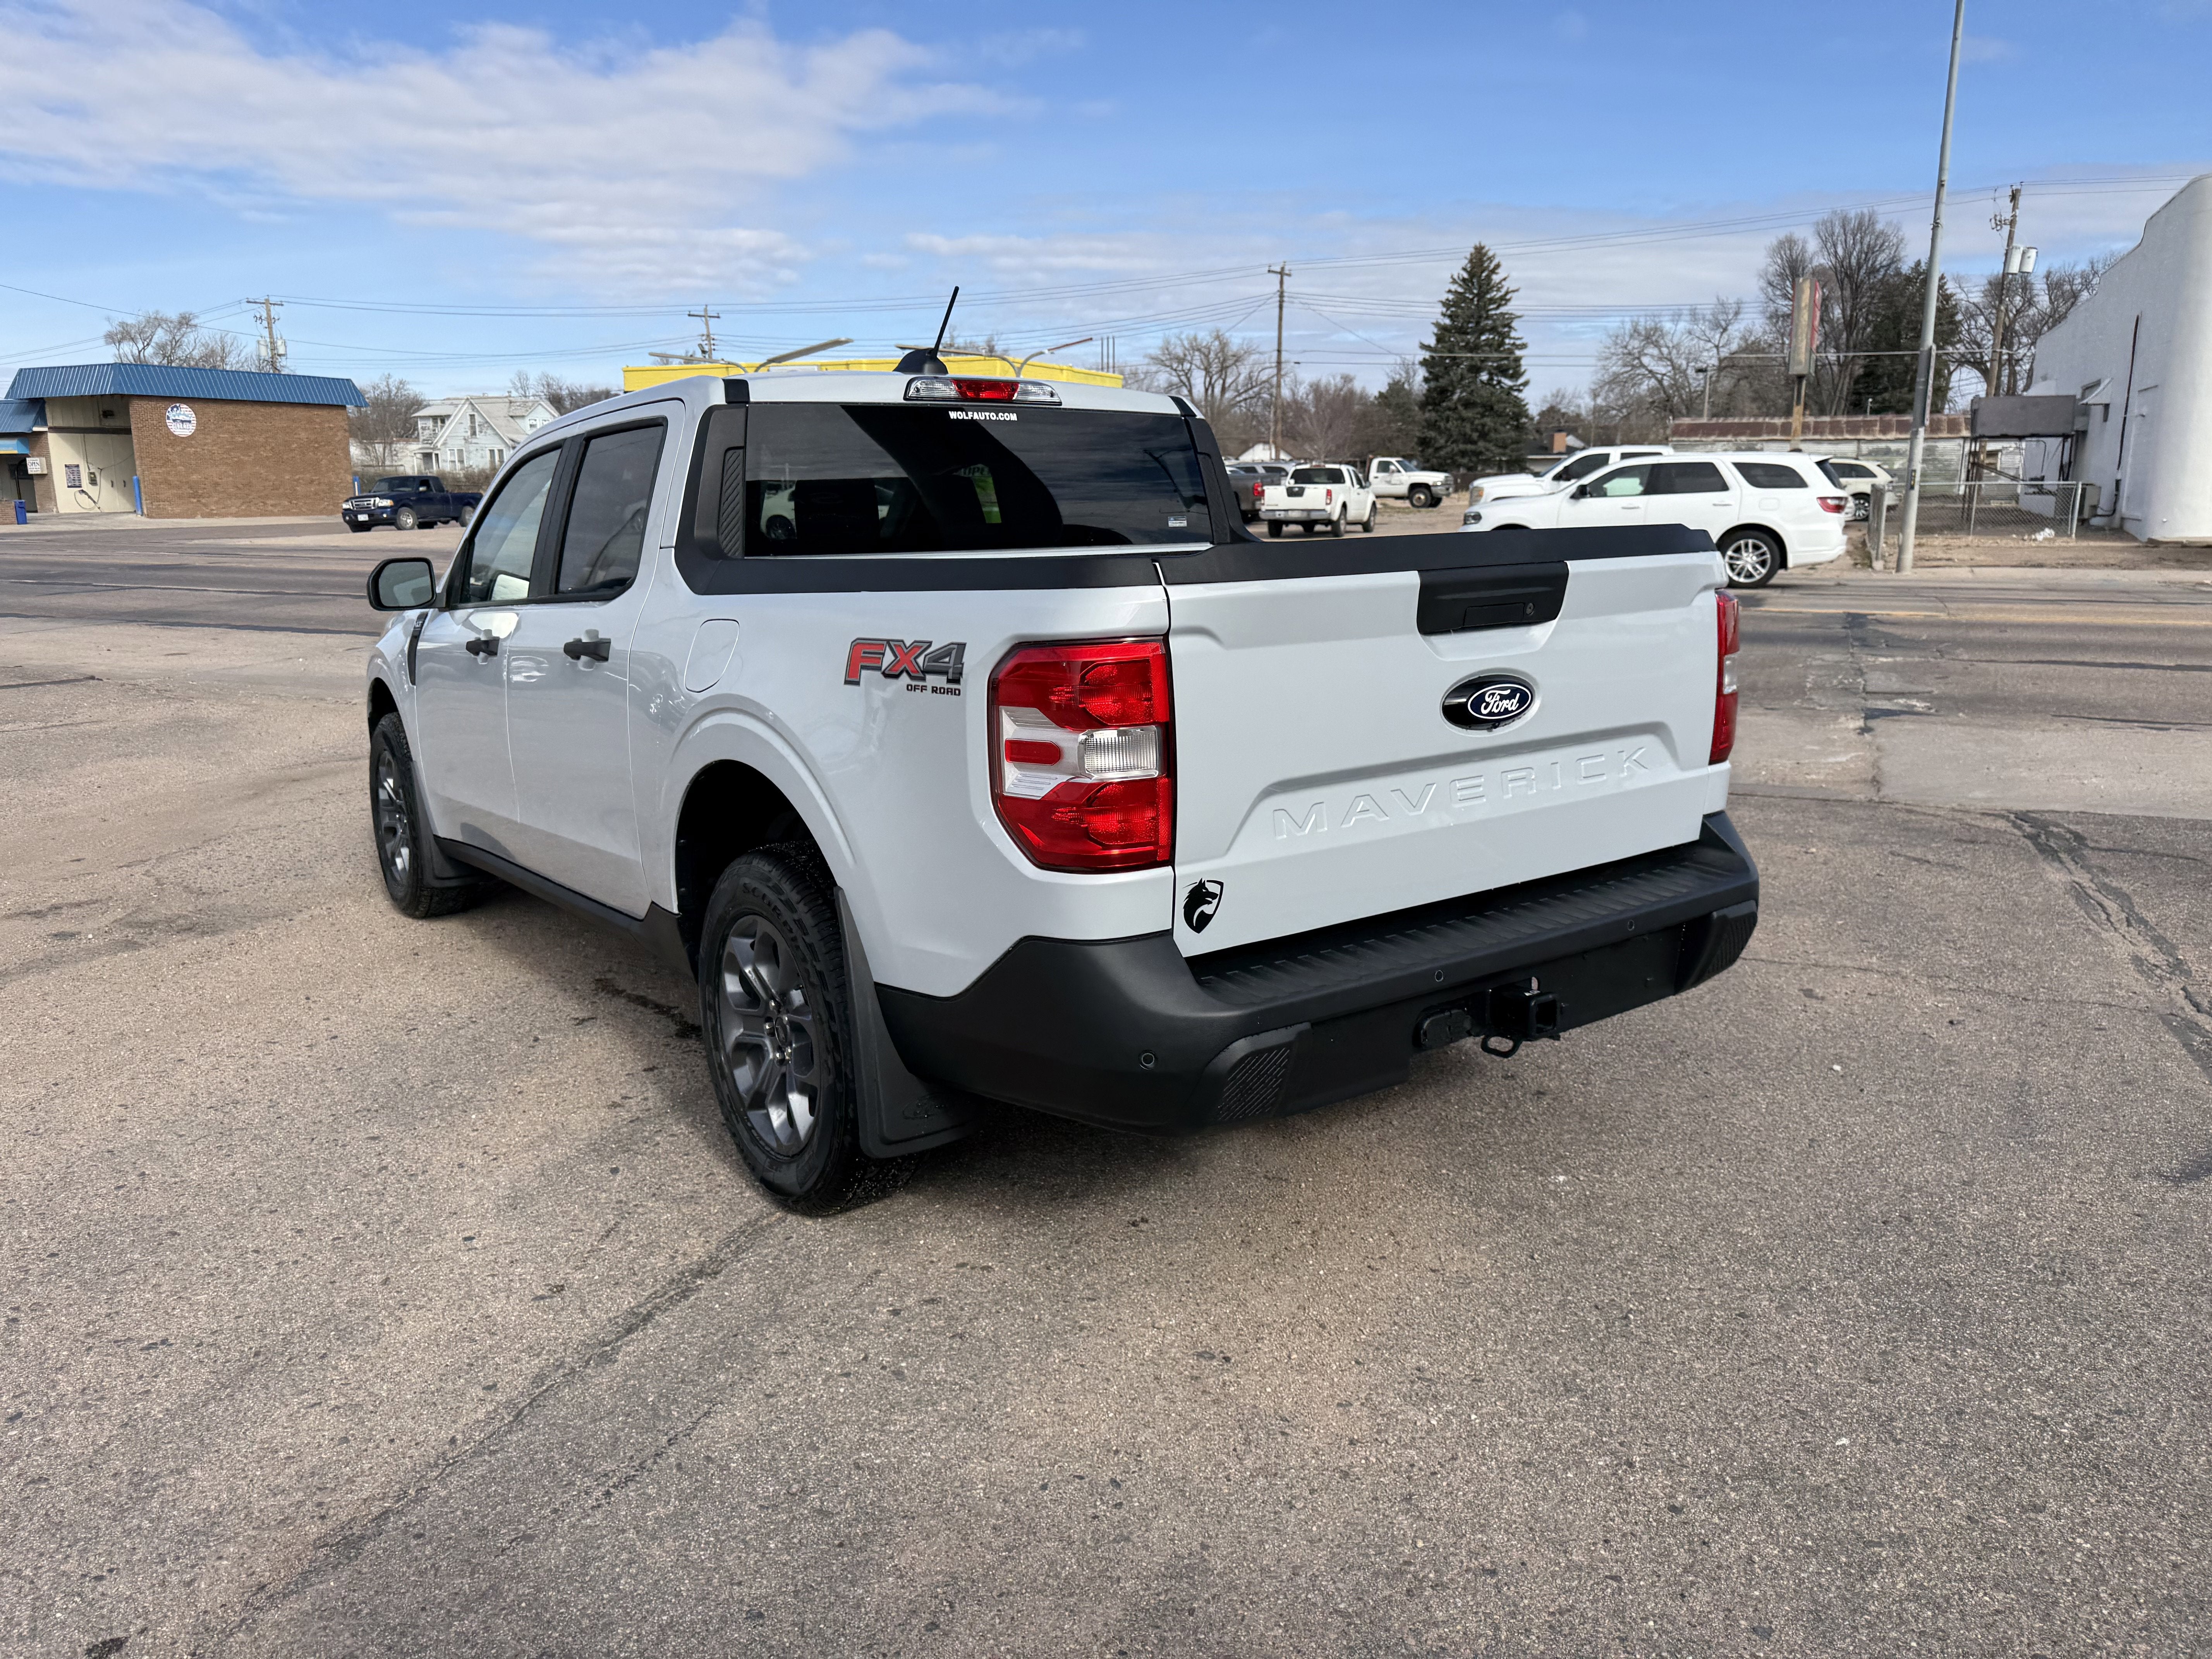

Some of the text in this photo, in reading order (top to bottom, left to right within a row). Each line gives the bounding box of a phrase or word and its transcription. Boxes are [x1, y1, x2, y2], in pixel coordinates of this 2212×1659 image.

[948, 410, 1018, 421] WOLFAUTO.COM
[843, 637, 967, 687] FX4
[906, 684, 961, 696] OFF ROAD
[1480, 689, 1520, 714] Ford
[1273, 747, 1649, 840] MAVERICK
